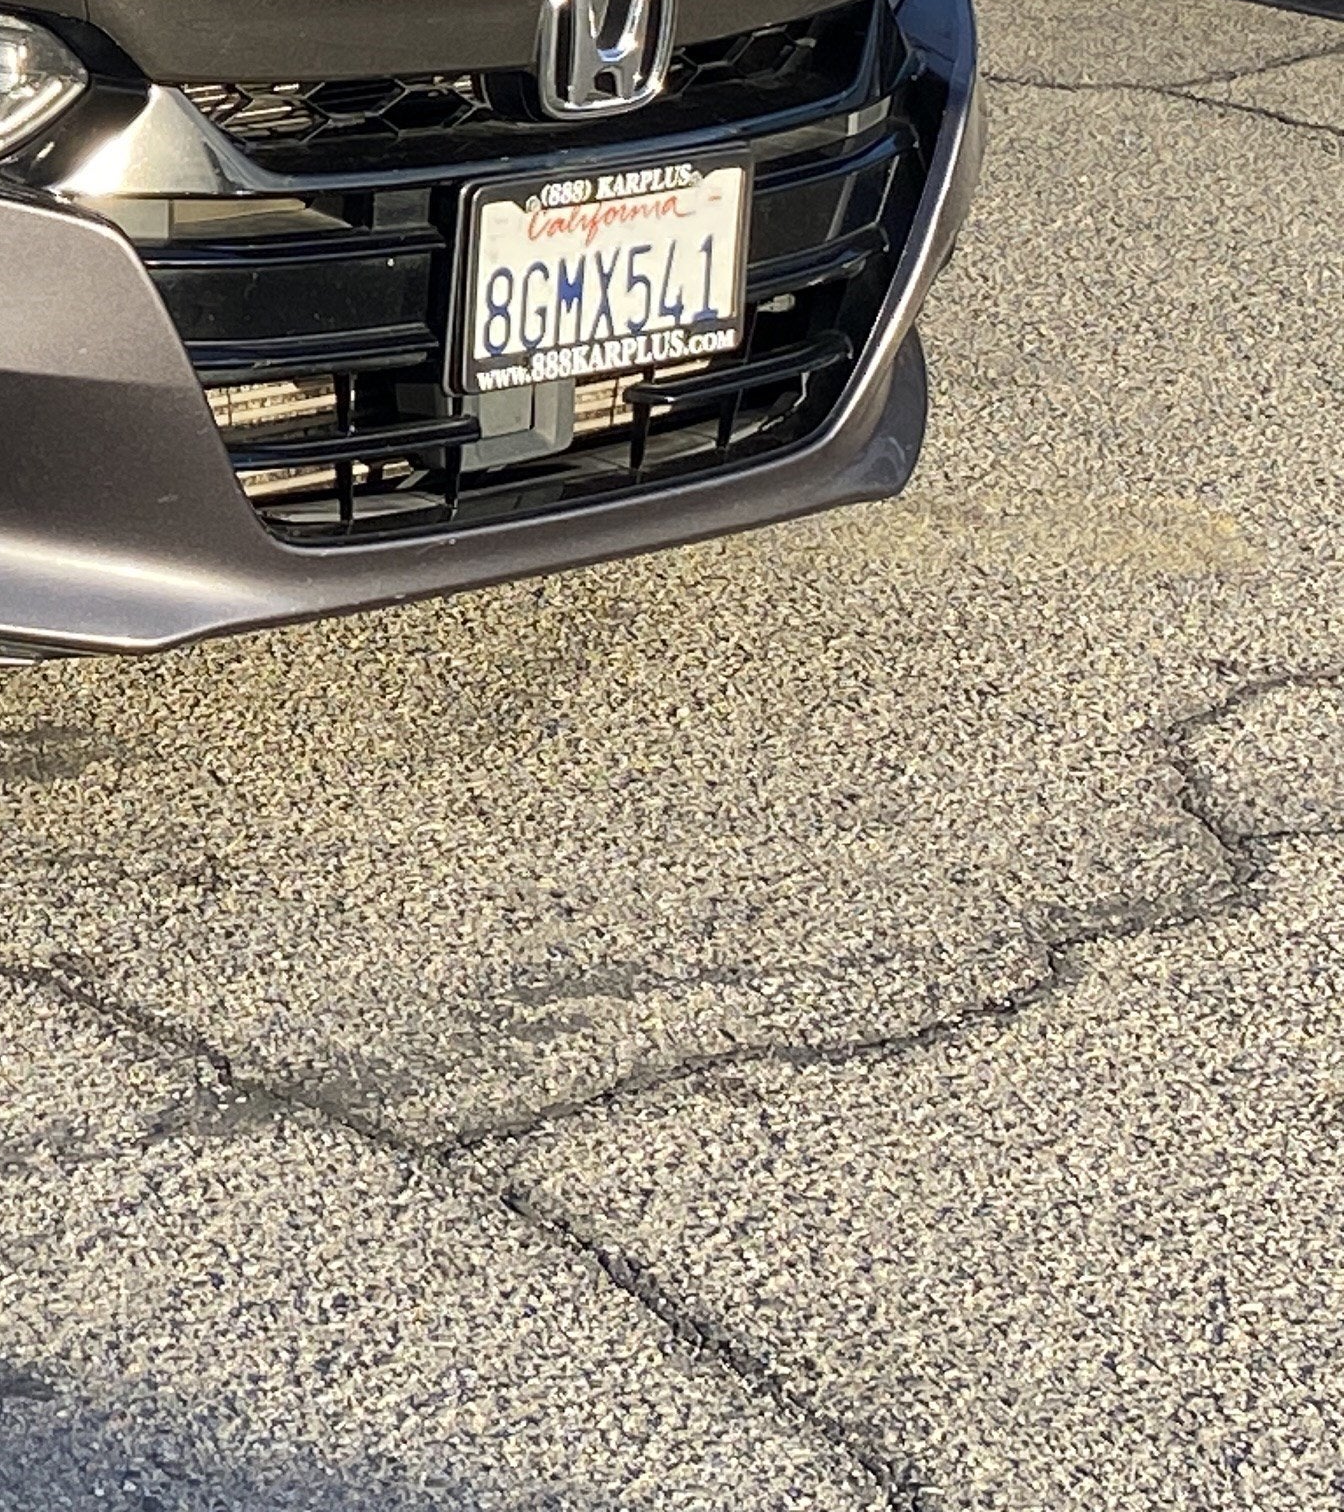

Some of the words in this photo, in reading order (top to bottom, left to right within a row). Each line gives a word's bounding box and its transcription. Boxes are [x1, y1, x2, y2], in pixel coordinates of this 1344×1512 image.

[540, 179, 592, 207] (888)
[595, 163, 693, 199] KARPLUS
[527, 193, 697, 248] California
[482, 234, 719, 357] 8GMX541
